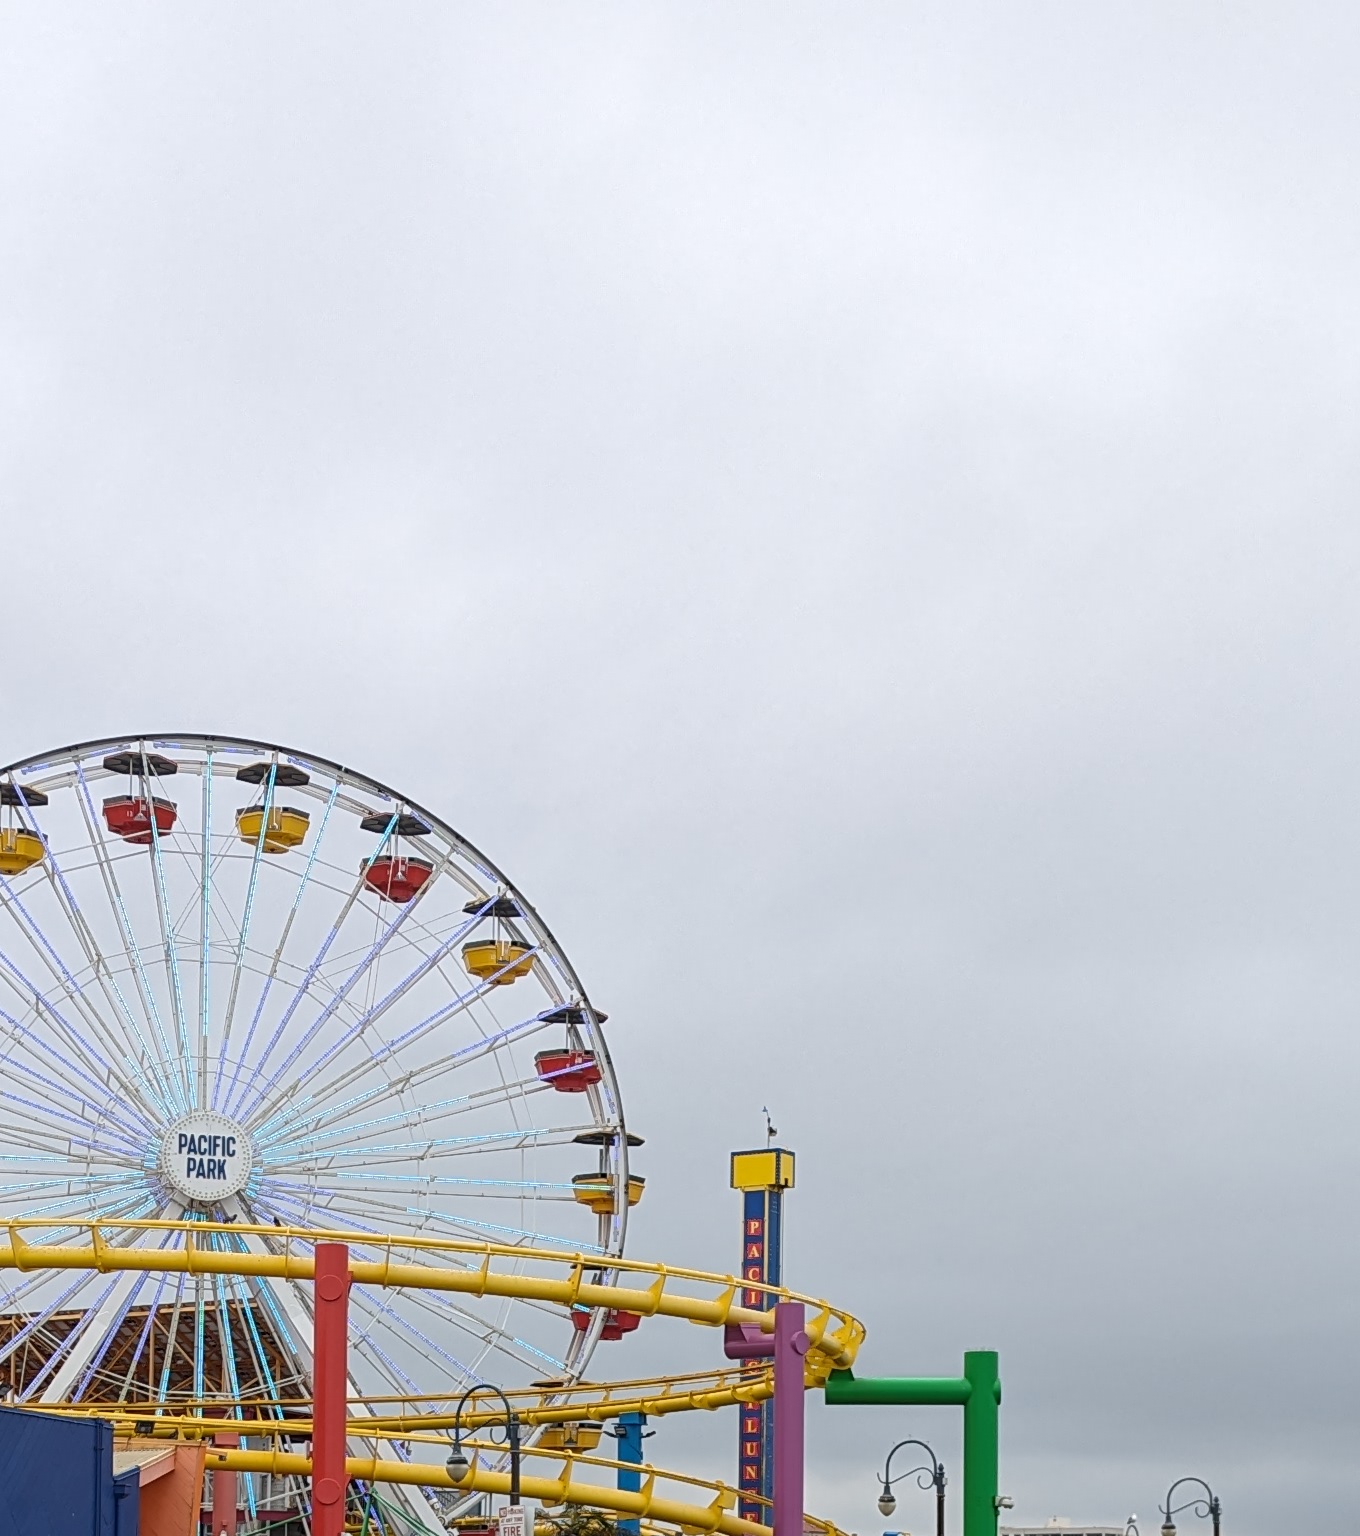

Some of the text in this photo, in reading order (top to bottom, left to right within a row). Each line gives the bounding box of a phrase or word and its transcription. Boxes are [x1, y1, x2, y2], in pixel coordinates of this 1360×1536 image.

[178, 1133, 236, 1157] PACIFIC
[187, 1157, 227, 1180] PARK
[503, 1526, 522, 1536] FIRE
